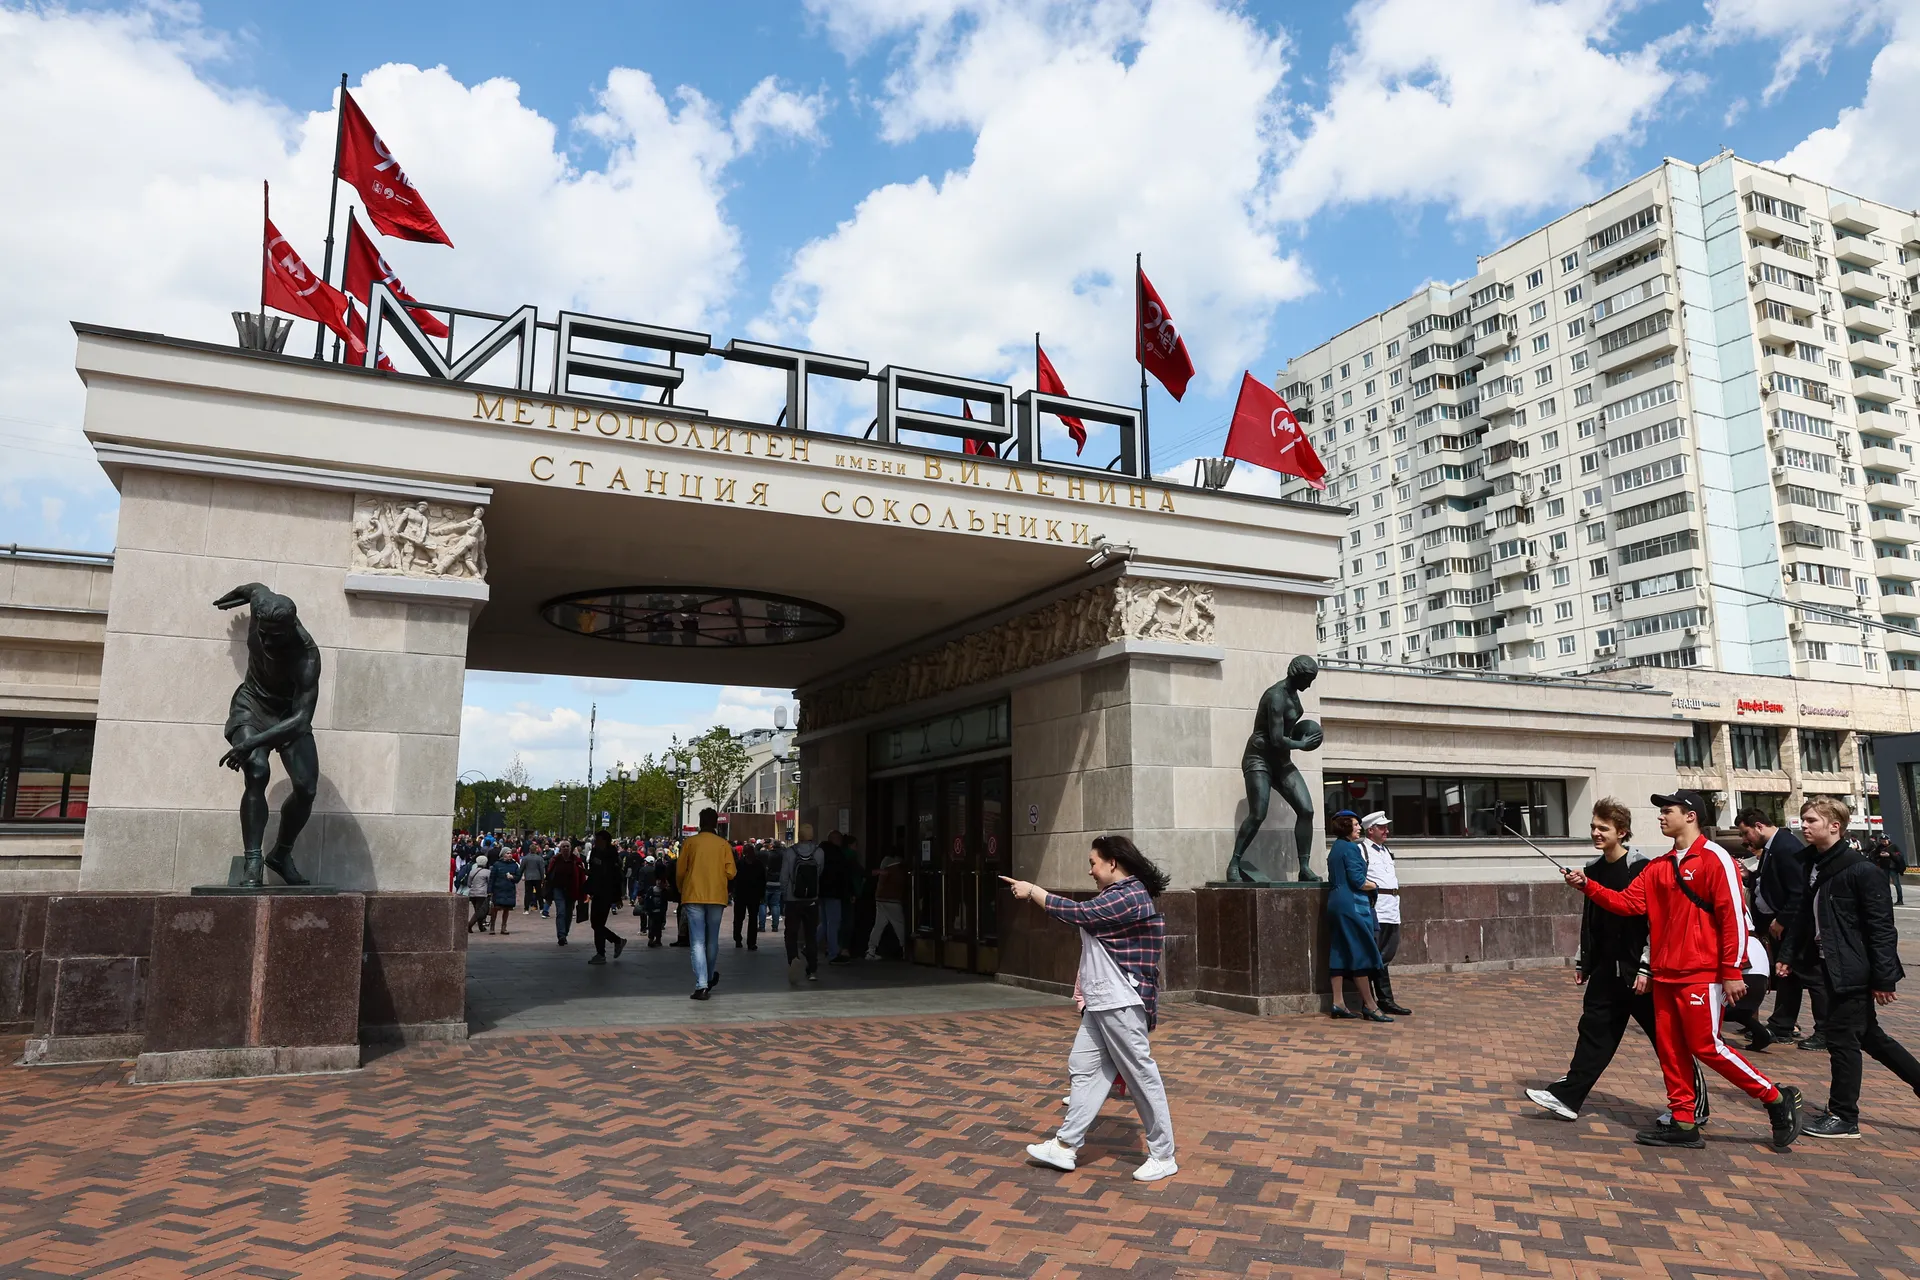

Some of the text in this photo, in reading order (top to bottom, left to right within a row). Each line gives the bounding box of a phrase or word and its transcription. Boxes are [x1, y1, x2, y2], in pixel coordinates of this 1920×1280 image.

[364, 281, 1143, 480] МЕТРО
[473, 392, 811, 463] МЕТРОПОЛИТЕН
[834, 453, 907, 476] ИМЕНИ
[529, 454, 1091, 546] СТАНЦИЯ СОКОЛЬНИКИ
[892, 704, 1000, 760] ВХОД
